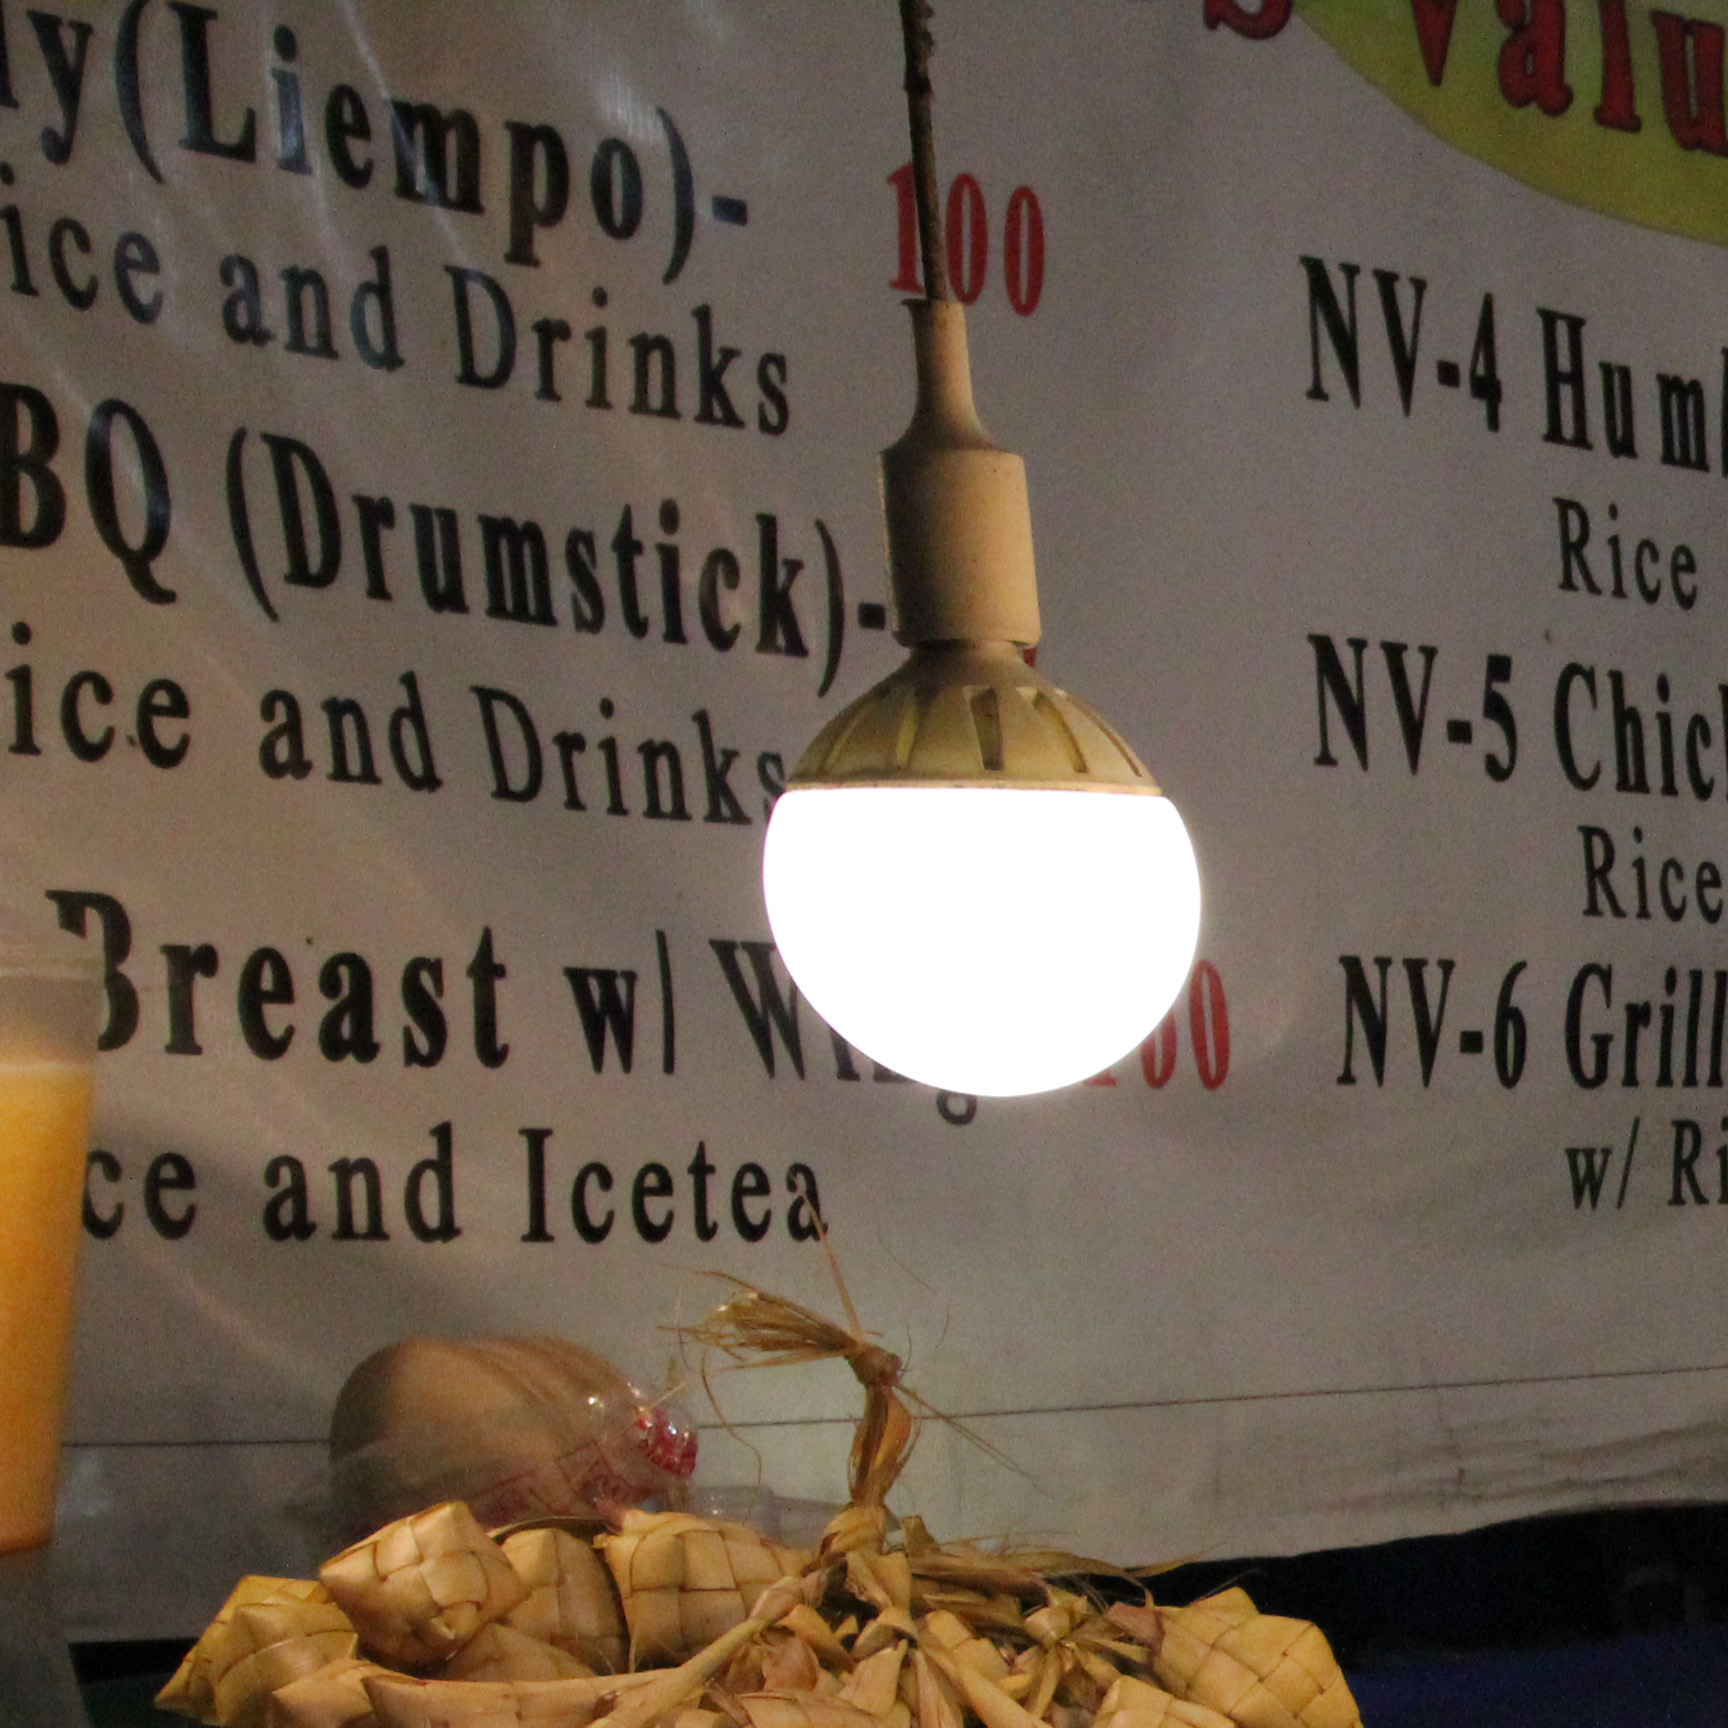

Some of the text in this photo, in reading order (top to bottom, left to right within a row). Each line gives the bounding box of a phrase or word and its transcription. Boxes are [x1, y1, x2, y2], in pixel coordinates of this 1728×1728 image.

[887, 162, 1046, 316] 100
[219, 246, 405, 371] and
[445, 264, 790, 437] Drinks
[1299, 255, 1502, 433] NV-4
[225, 425, 887, 699] (Drumstick)-
[1553, 498, 1700, 611] Rice
[258, 671, 443, 793] and
[1306, 633, 1519, 783] NV-5
[1578, 824, 1726, 925] Rice
[45, 890, 510, 1071] Breast
[1337, 955, 1528, 1090] NV-6
[263, 1120, 463, 1243] and
[518, 1127, 830, 1245] Icetea
[1564, 1116, 1642, 1211] w/
